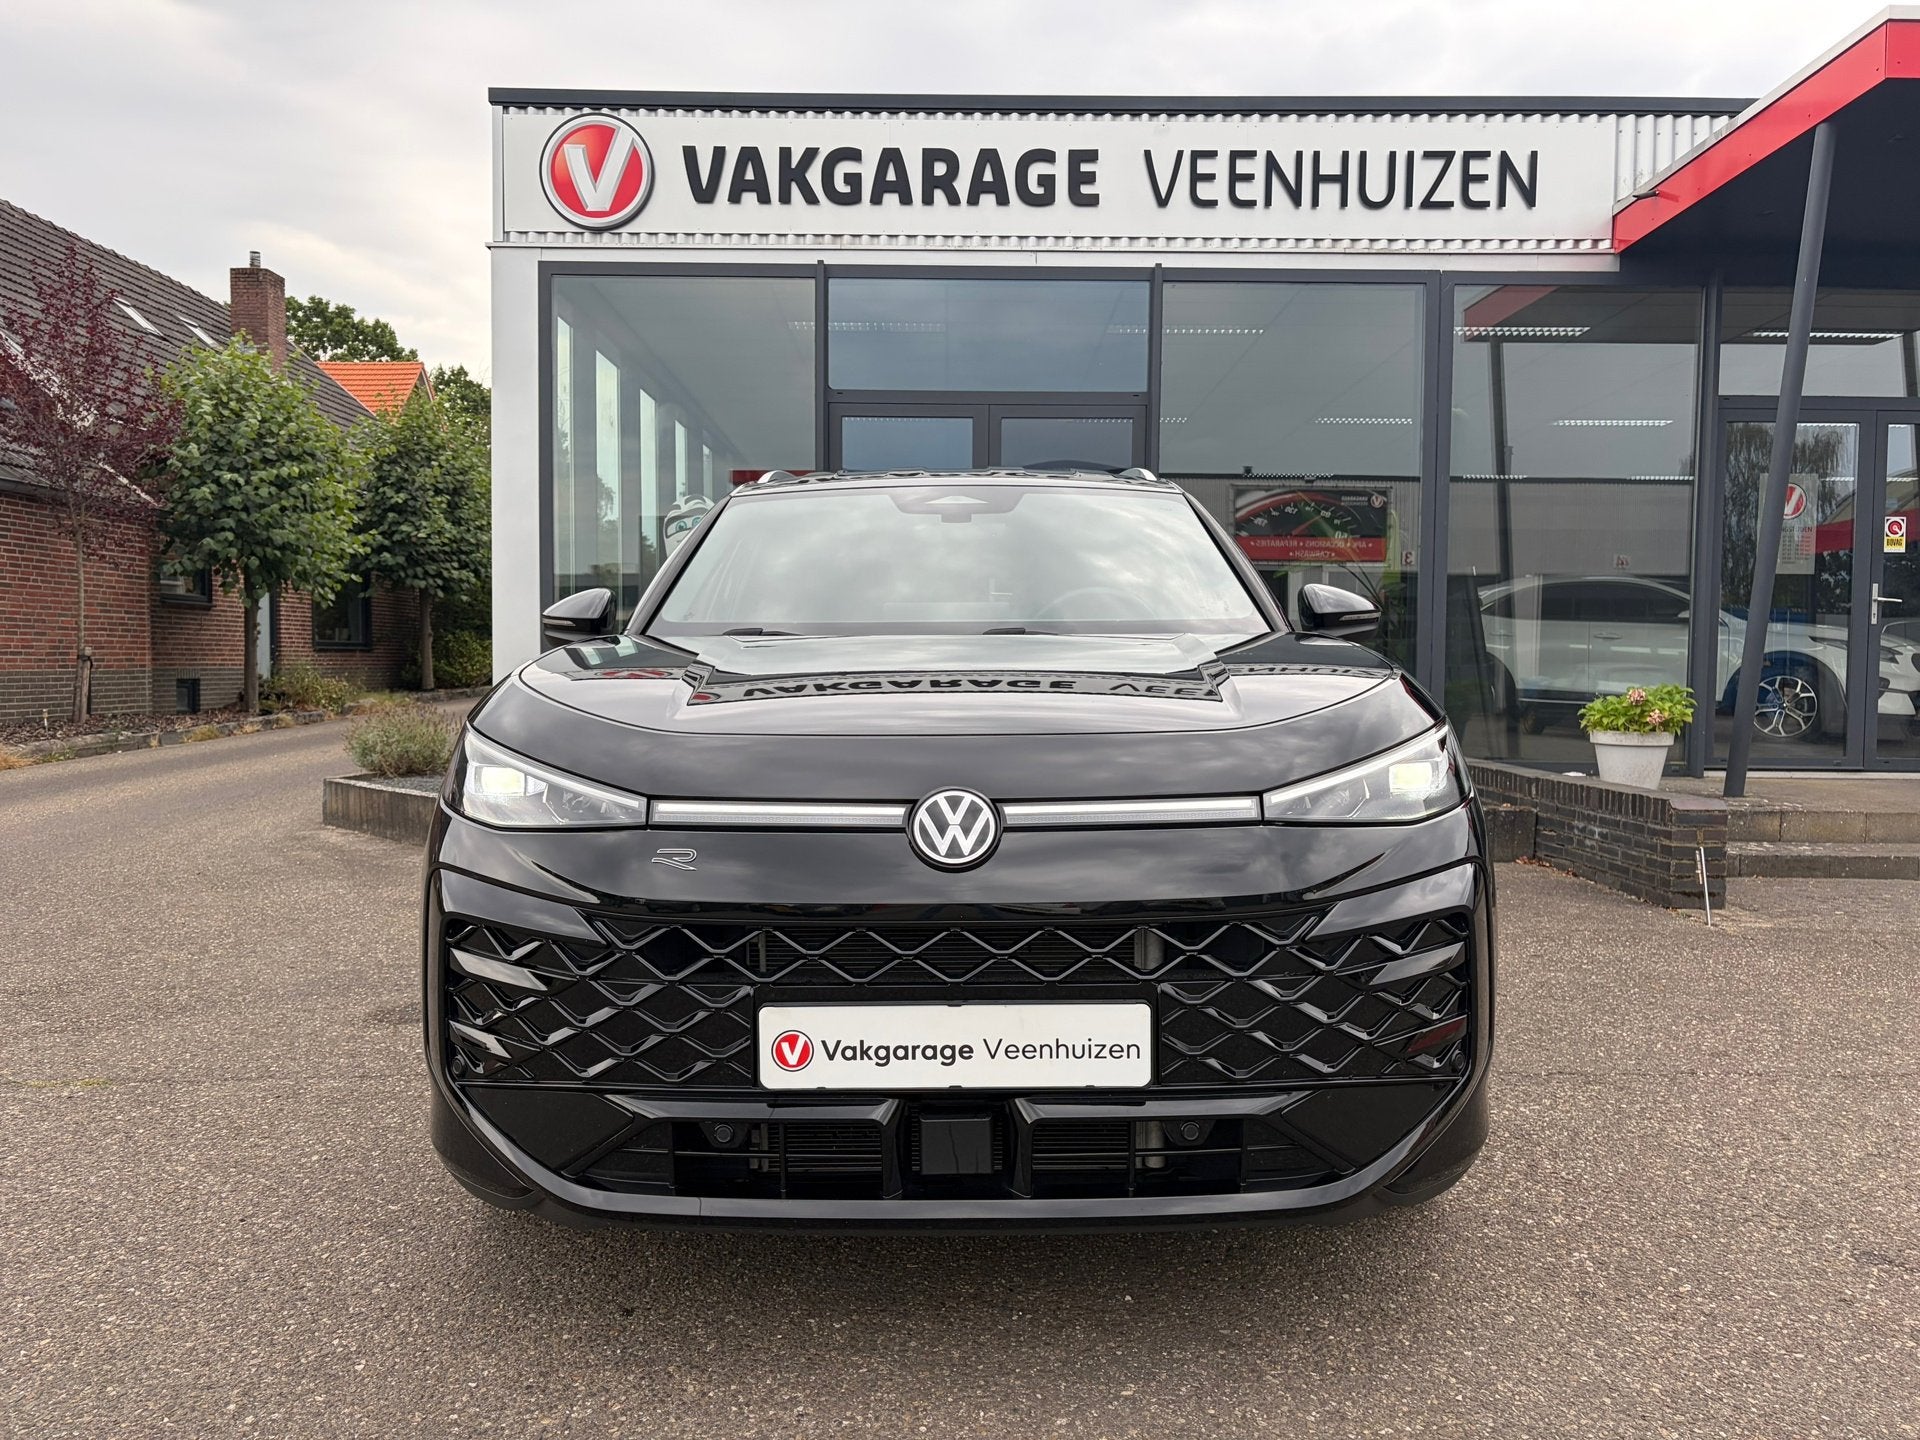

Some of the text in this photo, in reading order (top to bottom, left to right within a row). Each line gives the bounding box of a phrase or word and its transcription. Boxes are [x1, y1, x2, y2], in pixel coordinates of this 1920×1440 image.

[682, 145, 1538, 208] VAKGARAGE VEENHUIZEN
[1886, 538, 1903, 547] BOVAG
[821, 1037, 1141, 1067] Vakgarage Veenhuizen
